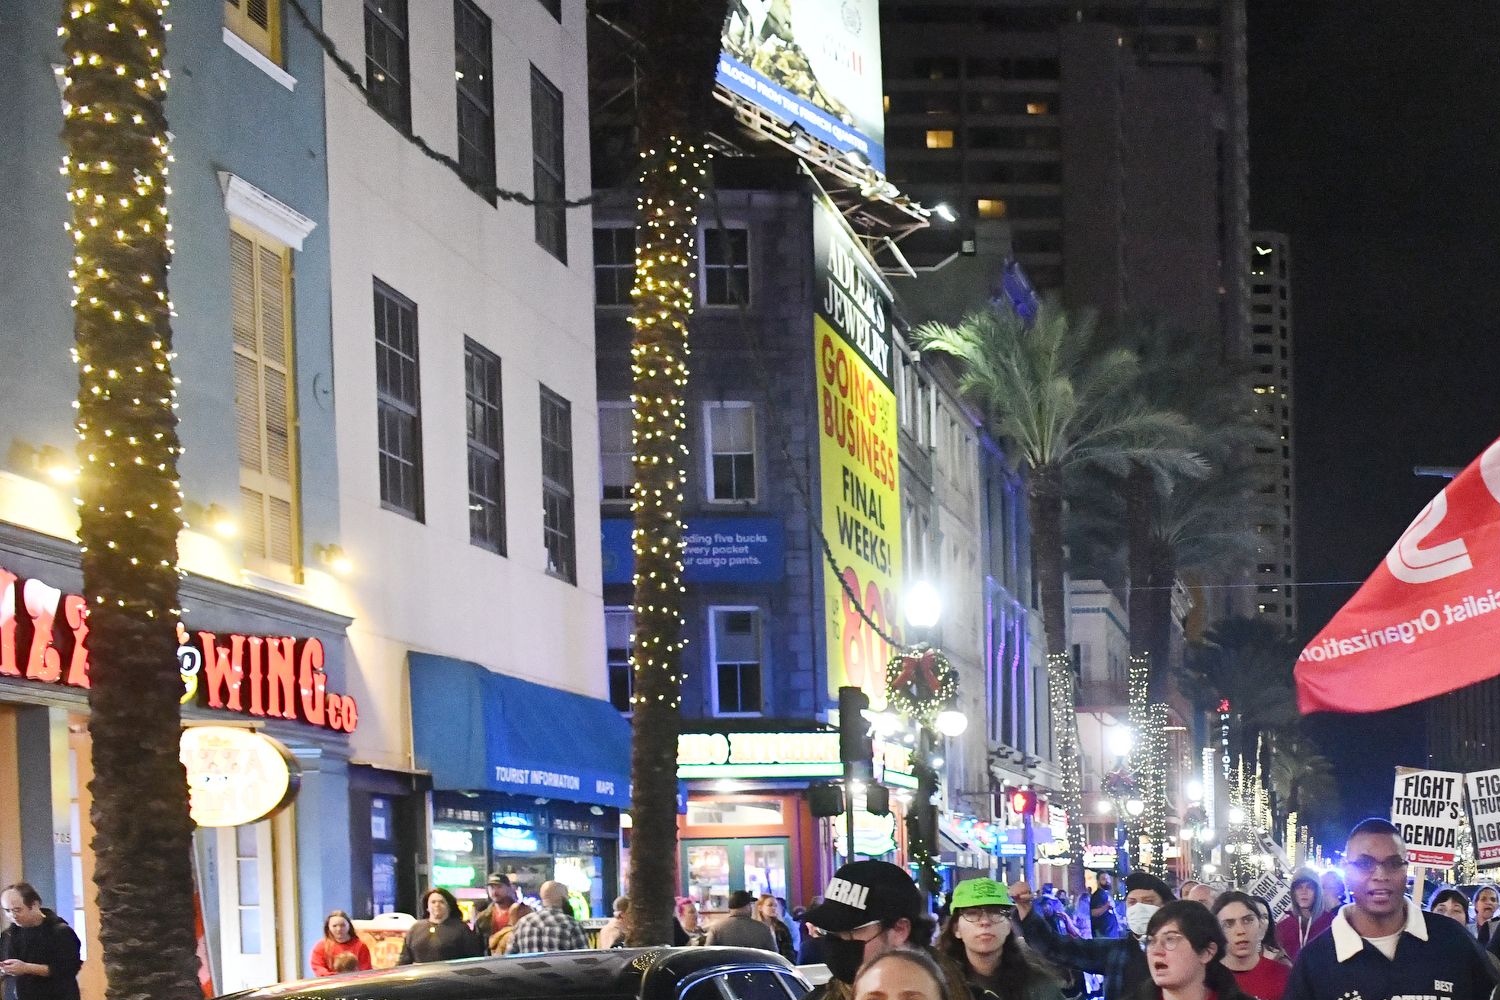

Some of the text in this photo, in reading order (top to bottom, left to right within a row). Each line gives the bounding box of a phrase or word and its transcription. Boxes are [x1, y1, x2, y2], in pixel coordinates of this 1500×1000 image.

[827, 236, 886, 334] ADLER'S
[824, 276, 890, 378] JEWELRY
[822, 334, 877, 426] GOING
[823, 385, 895, 492] BUSINESS
[842, 464, 886, 531] FINAL
[712, 545, 749, 556] pocket
[714, 533, 734, 543] five
[735, 533, 768, 543] bucks
[836, 505, 892, 578] WEEKS!
[696, 557, 727, 568] cargo
[729, 556, 762, 567] pants.
[198, 630, 359, 734] WING CO
[495, 766, 530, 785] TOURIST
[530, 770, 580, 791] INFORMATION
[596, 779, 614, 796] MAPS
[1404, 775, 1455, 800] FIGHT
[1395, 797, 1459, 820] TRUMP'S
[1263, 880, 1284, 903] UMP'S
[1434, 979, 1454, 993] BEST
